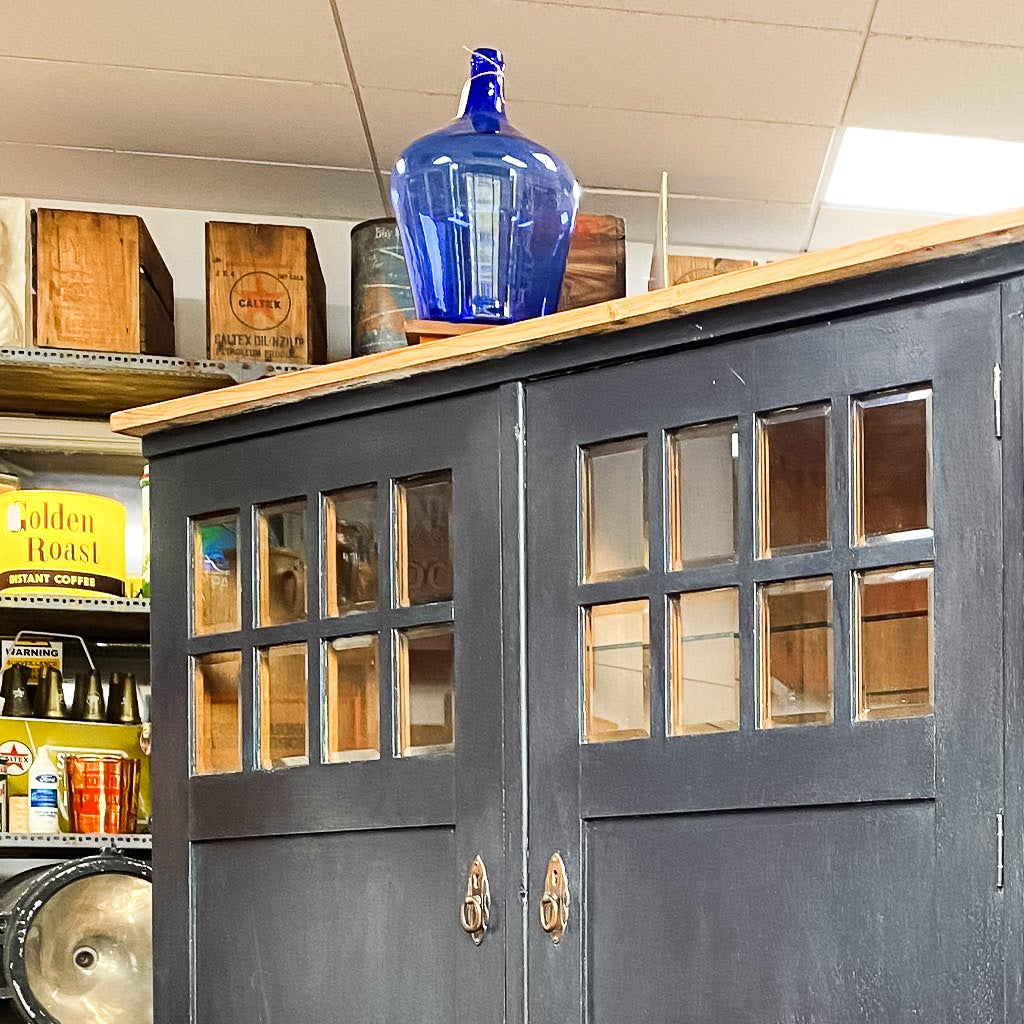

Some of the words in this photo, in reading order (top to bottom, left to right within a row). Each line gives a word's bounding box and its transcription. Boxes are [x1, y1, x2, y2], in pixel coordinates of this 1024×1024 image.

[239, 297, 281, 309] CALTEX
[214, 333, 252, 346] CALTEX
[7, 500, 94, 534] Golden
[28, 537, 99, 565] Roast
[9, 574, 51, 584] INSTANT
[54, 574, 96, 587] COFFEE
[6, 647, 59, 657] WARNING
